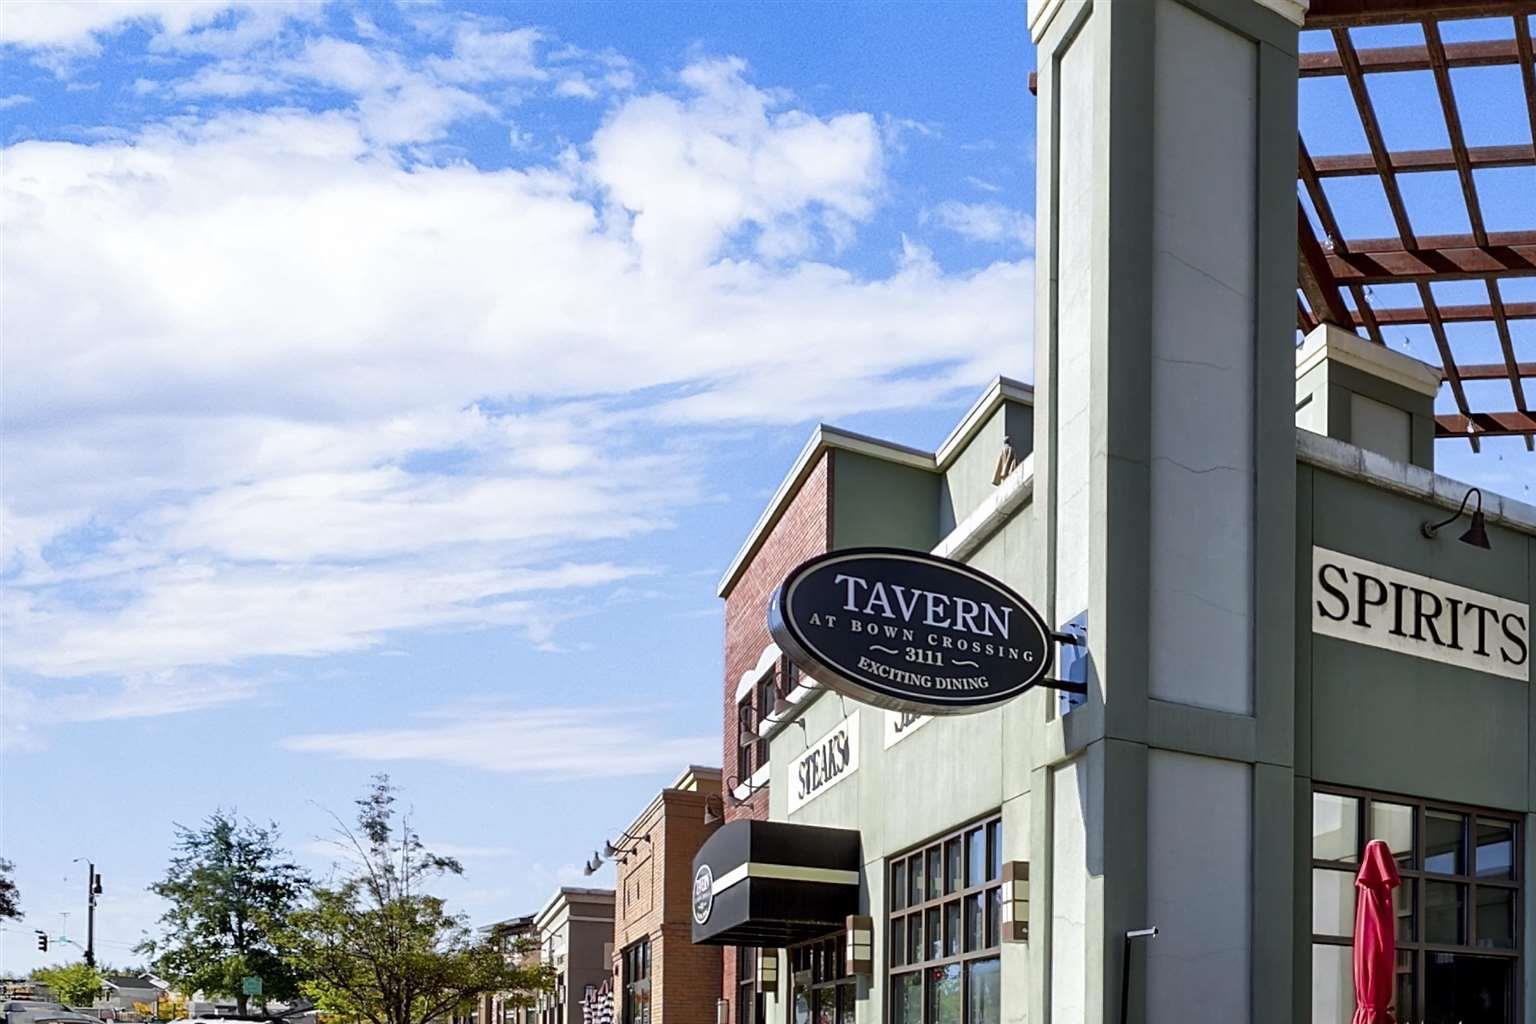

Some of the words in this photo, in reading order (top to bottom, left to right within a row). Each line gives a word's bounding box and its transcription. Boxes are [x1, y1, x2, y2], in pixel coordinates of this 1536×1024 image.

[834, 573, 1013, 640] TAVERN
[1317, 563, 1527, 664] SPIRITS
[809, 613, 837, 628] AT
[851, 619, 915, 642] BOWN
[927, 633, 1034, 662] CROSSING
[905, 646, 944, 667] 3111
[857, 656, 932, 688] EXCITING
[935, 676, 989, 690] DINING
